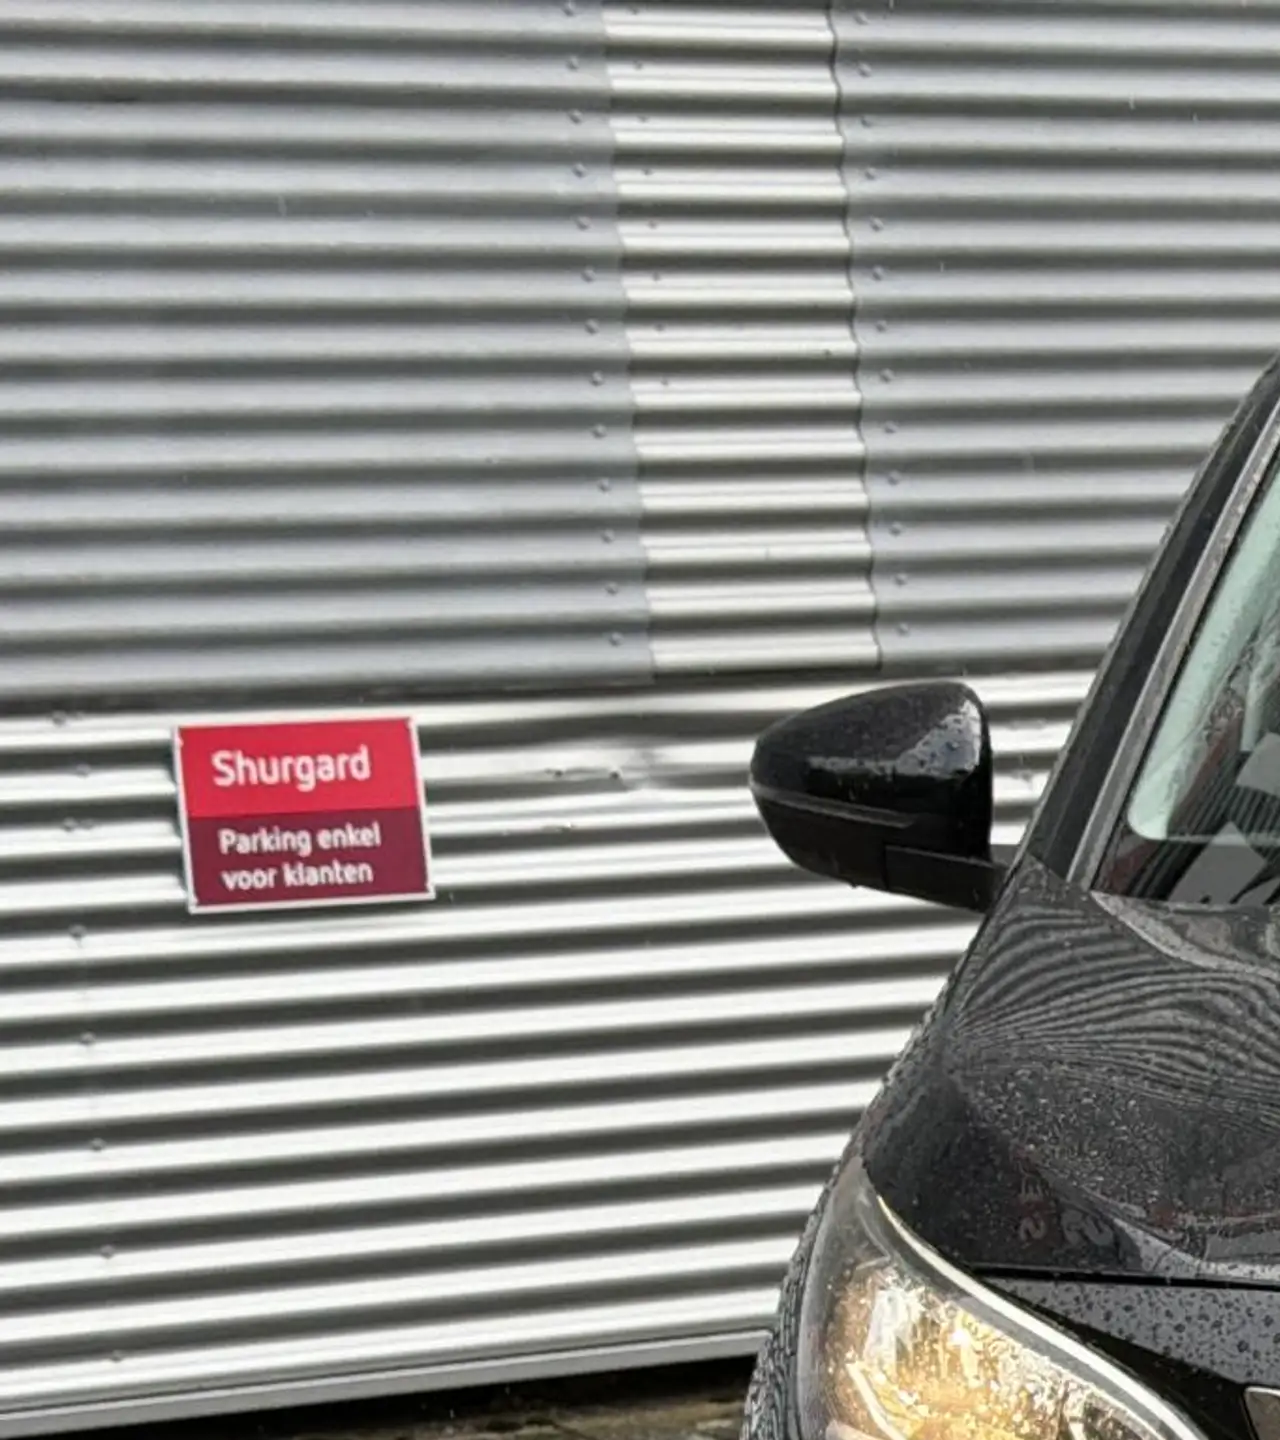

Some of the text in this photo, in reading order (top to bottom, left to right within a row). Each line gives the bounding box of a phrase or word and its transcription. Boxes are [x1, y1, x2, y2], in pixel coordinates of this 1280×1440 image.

[211, 744, 371, 792] Shurgard
[218, 820, 381, 858] Parking enkel
[221, 859, 374, 891] voor klanten
